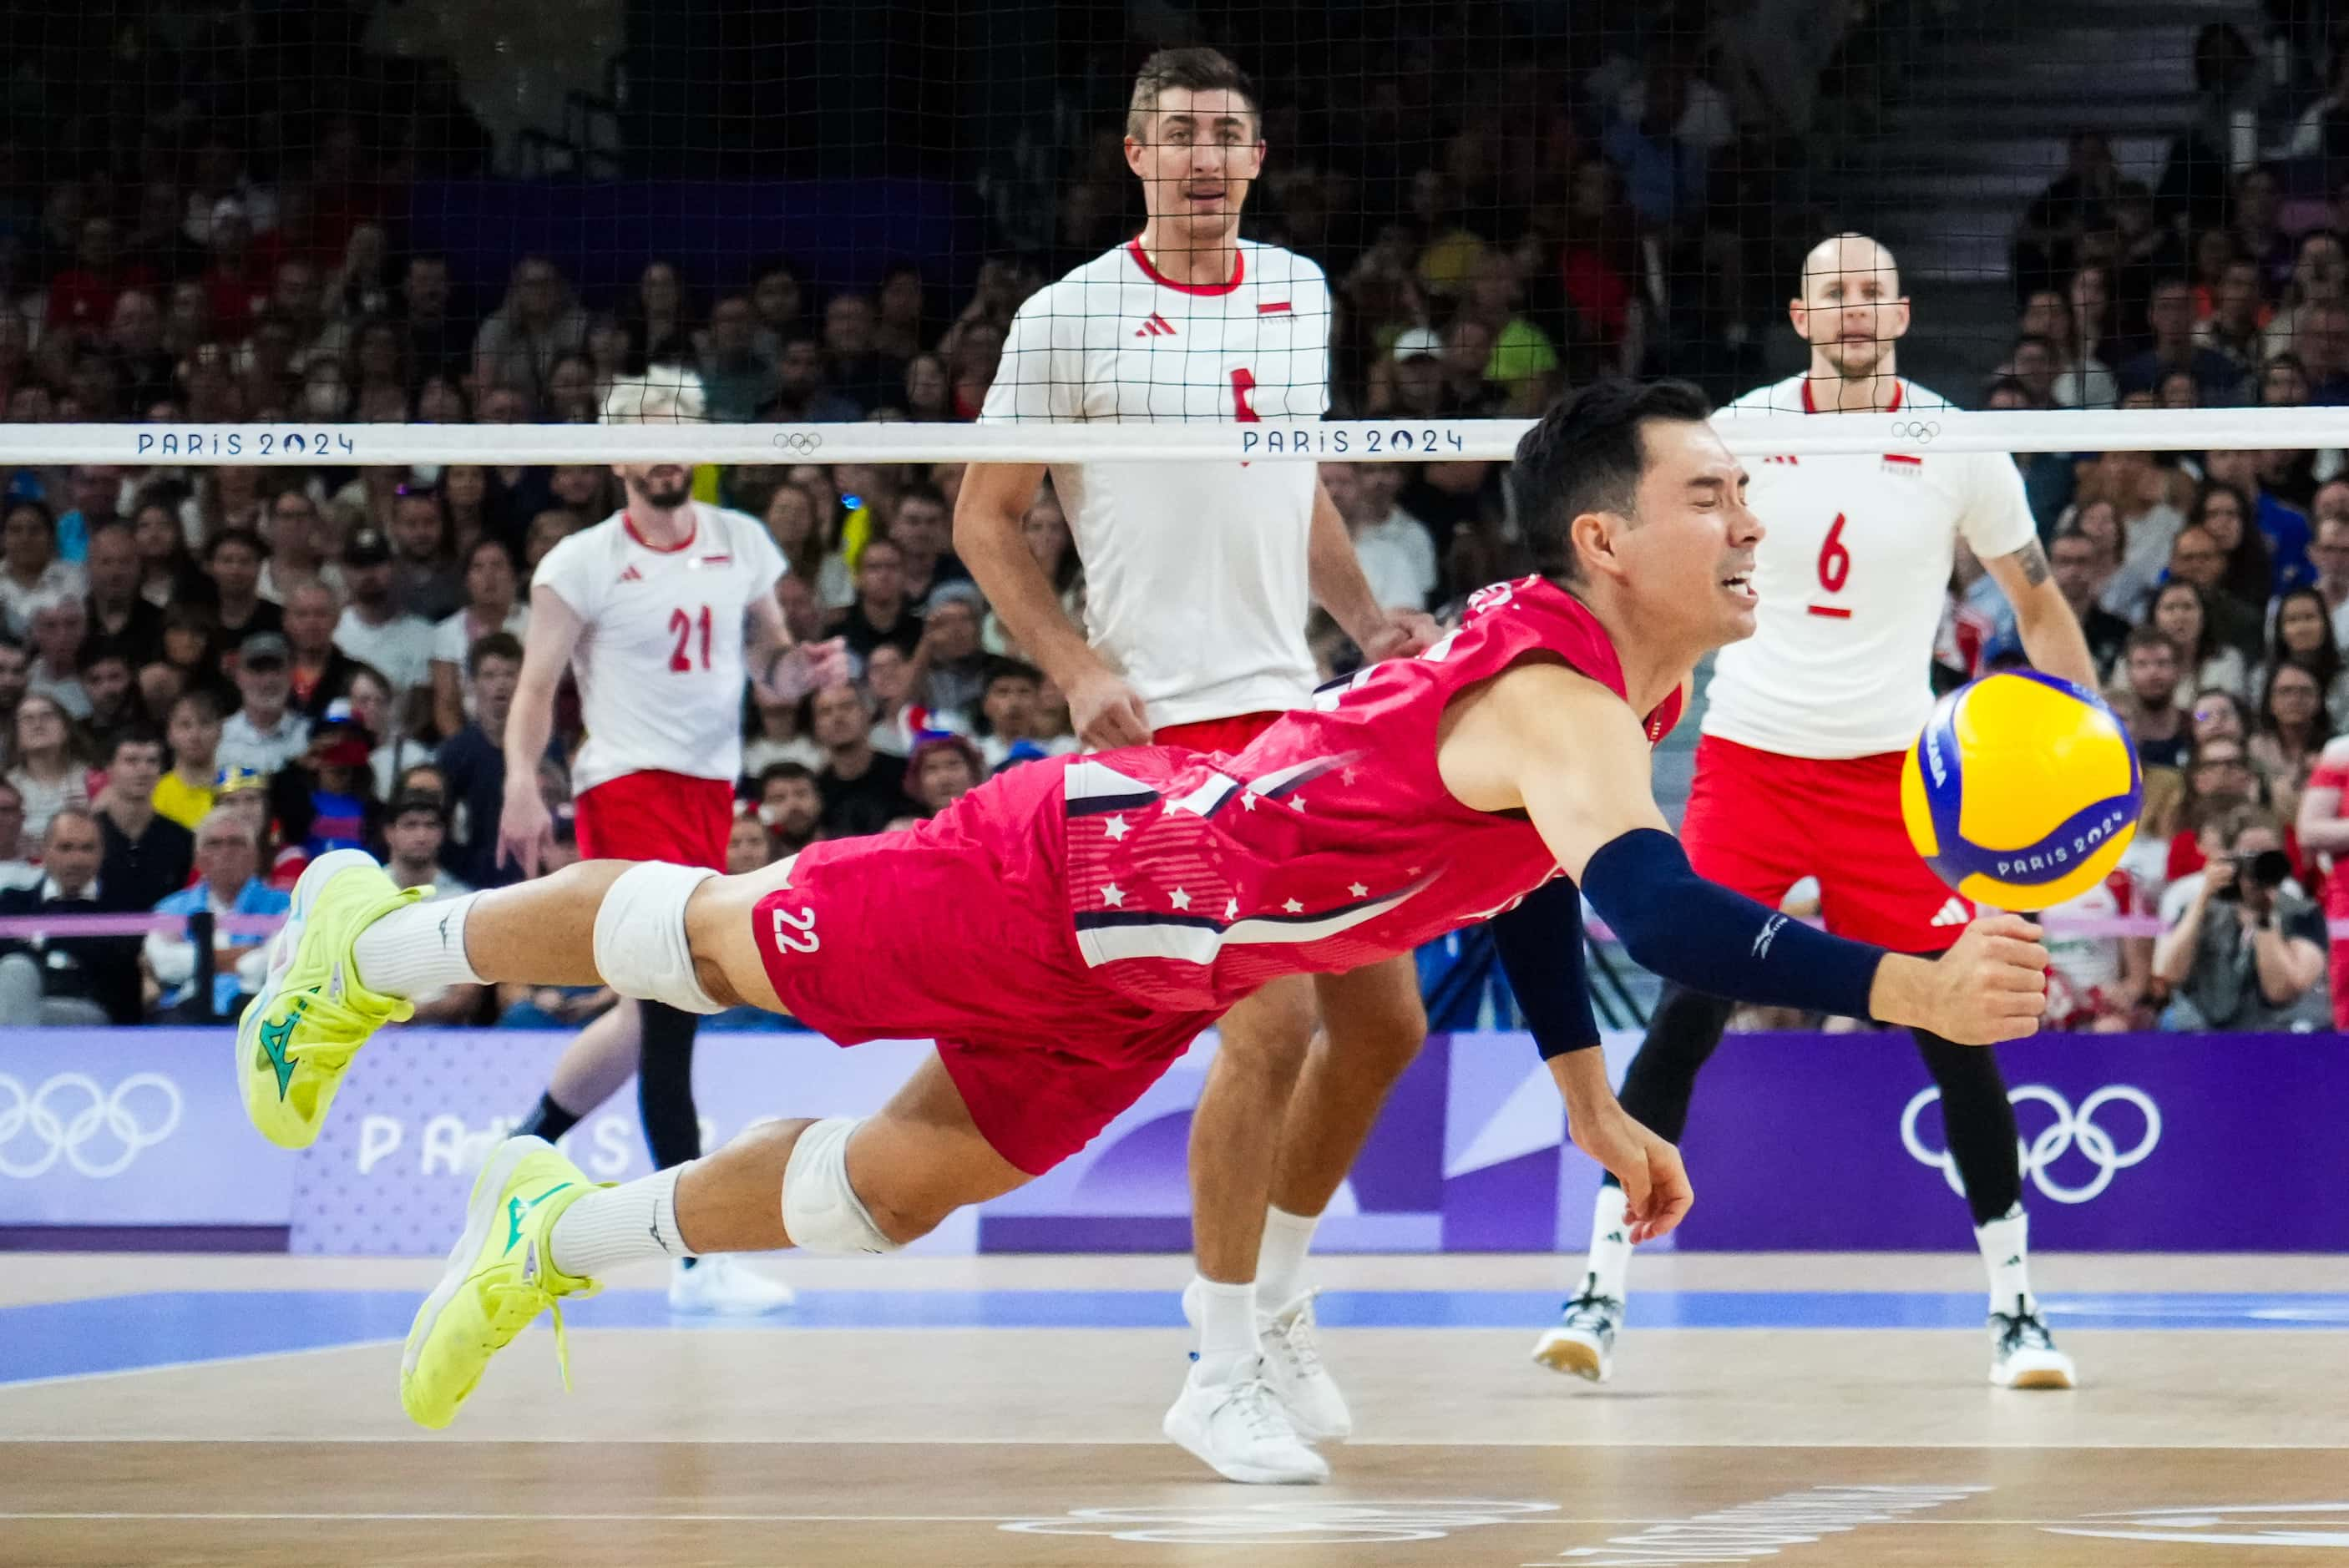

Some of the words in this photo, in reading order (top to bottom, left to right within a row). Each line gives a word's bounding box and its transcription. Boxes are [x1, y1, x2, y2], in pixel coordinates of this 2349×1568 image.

[260, 433, 353, 455] 2024
[1367, 429, 1461, 452] 2024
[1819, 511, 1850, 593] 6
[669, 604, 712, 673] 21
[1997, 847, 2068, 876] PARIS
[772, 907, 820, 954] 22
